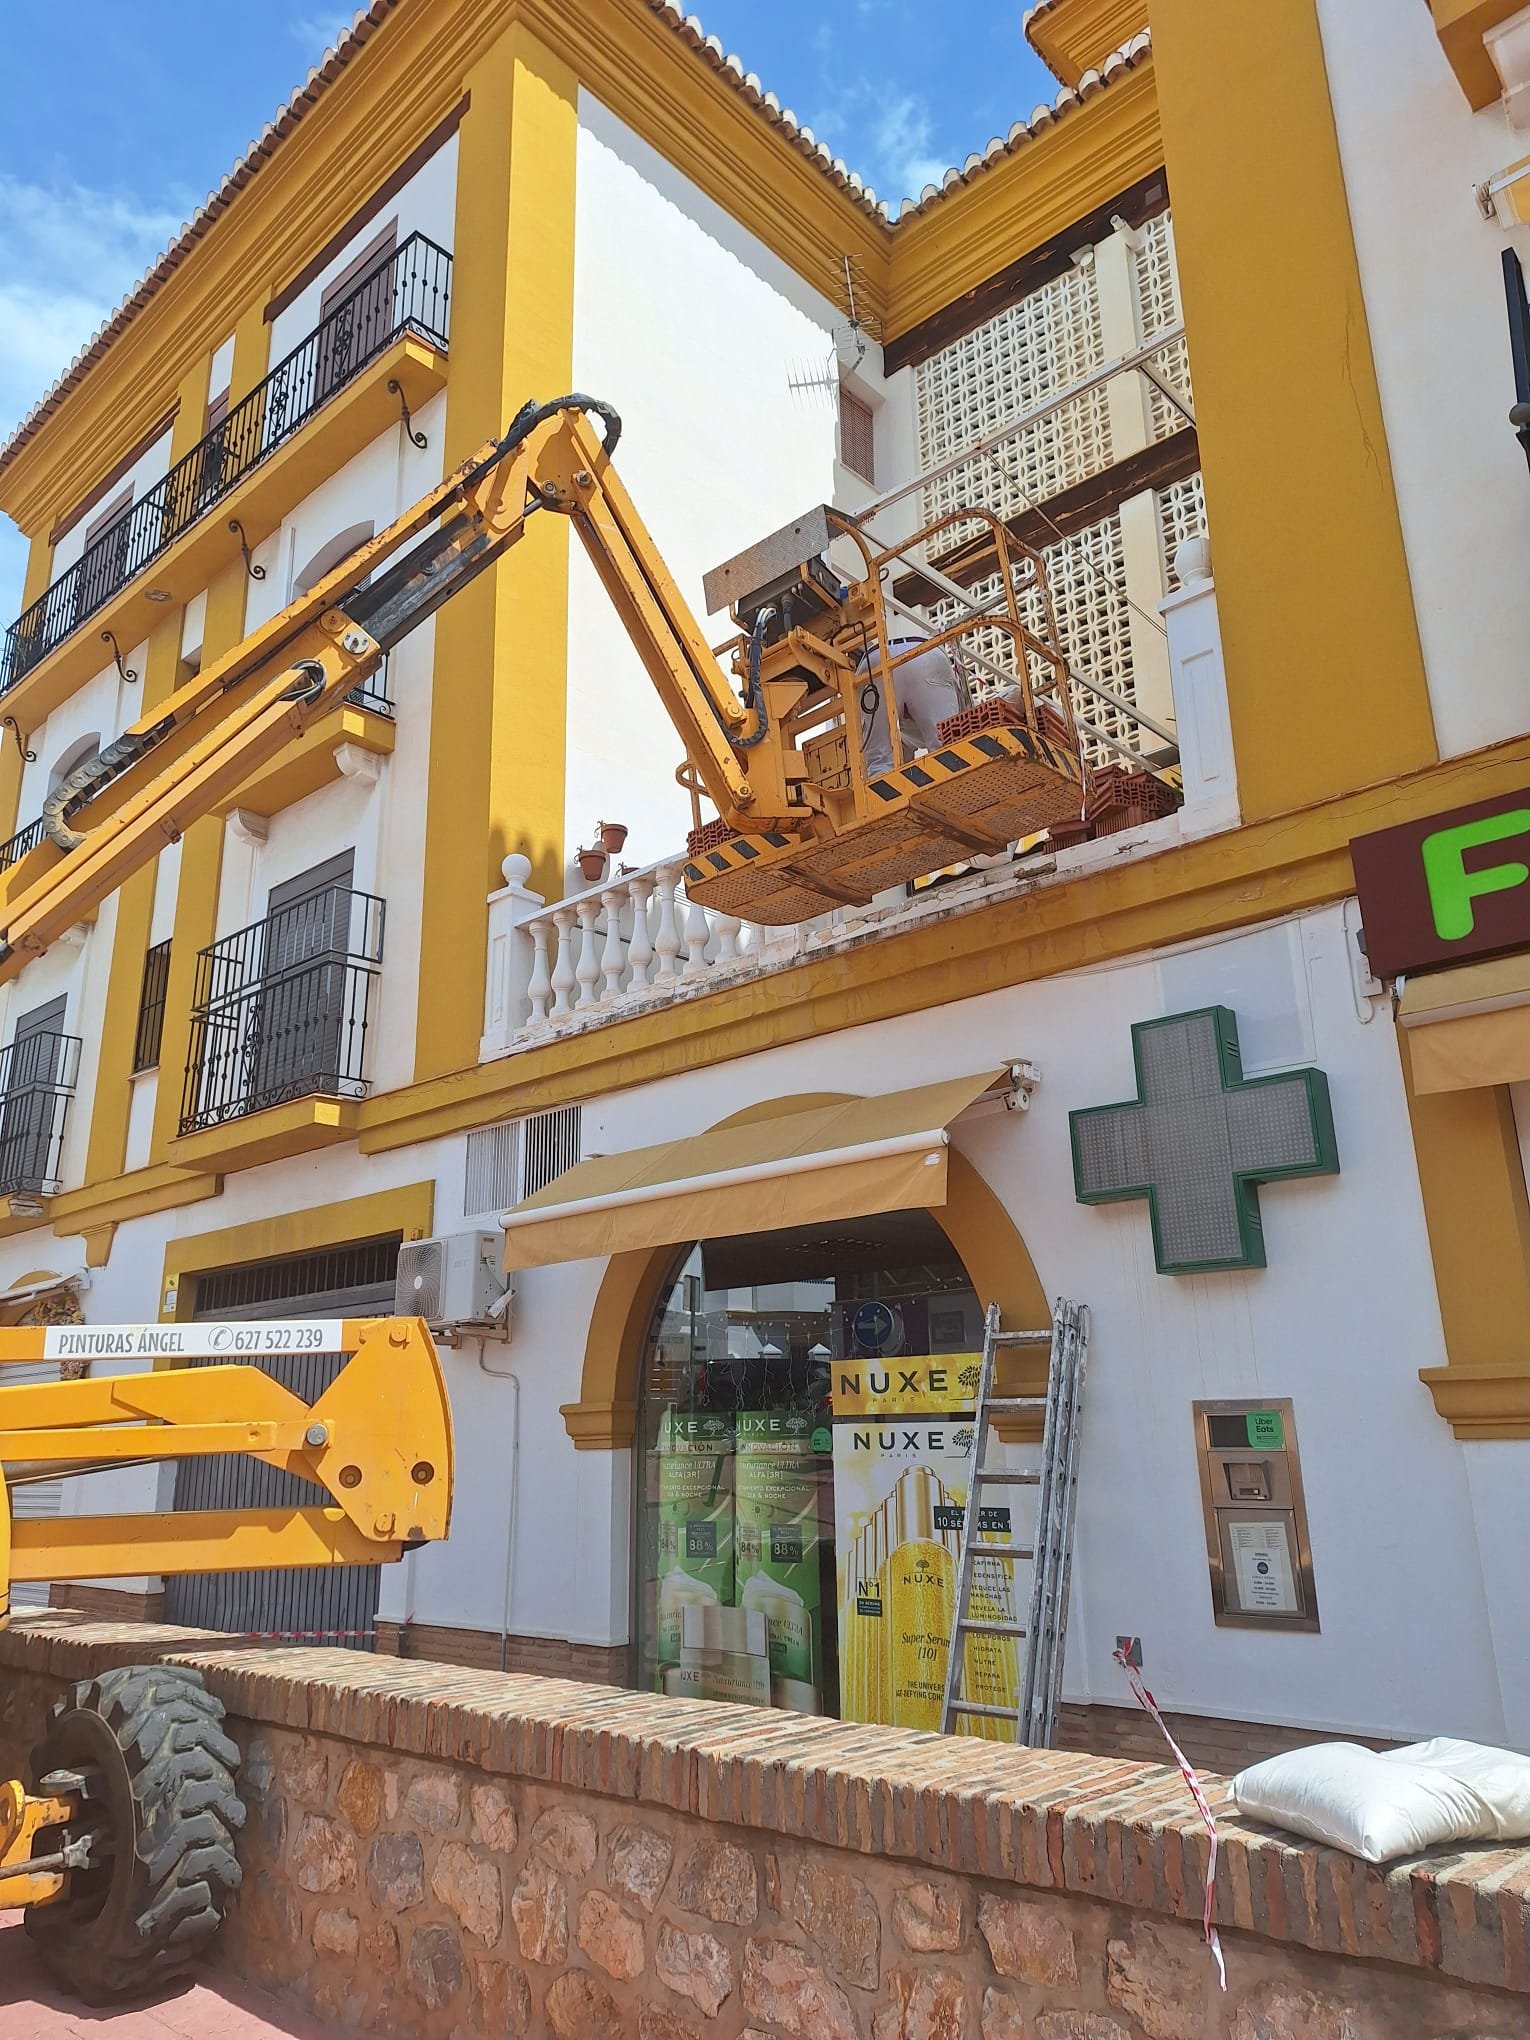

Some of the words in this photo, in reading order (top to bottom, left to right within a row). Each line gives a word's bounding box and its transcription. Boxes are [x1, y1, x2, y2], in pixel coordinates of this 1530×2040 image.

[1421, 808, 1530, 941] F
[58, 1333, 134, 1354] PINTURAS
[137, 1328, 185, 1353] ÁNGEL
[235, 1330, 262, 1350] 627
[265, 1330, 291, 1349] 522
[296, 1328, 323, 1348] 239
[841, 1369, 949, 1395] NUXE
[661, 1421, 699, 1434] UXE
[854, 1431, 945, 1451] NUXE
[937, 1516, 948, 1528] 10
[991, 1521, 1004, 1529] EN
[903, 1574, 945, 1589] NUXE
[973, 1572, 1013, 1580] EDENSIFICA
[971, 1612, 1018, 1622] LUMINOSIDAD
[901, 1632, 925, 1646] Super
